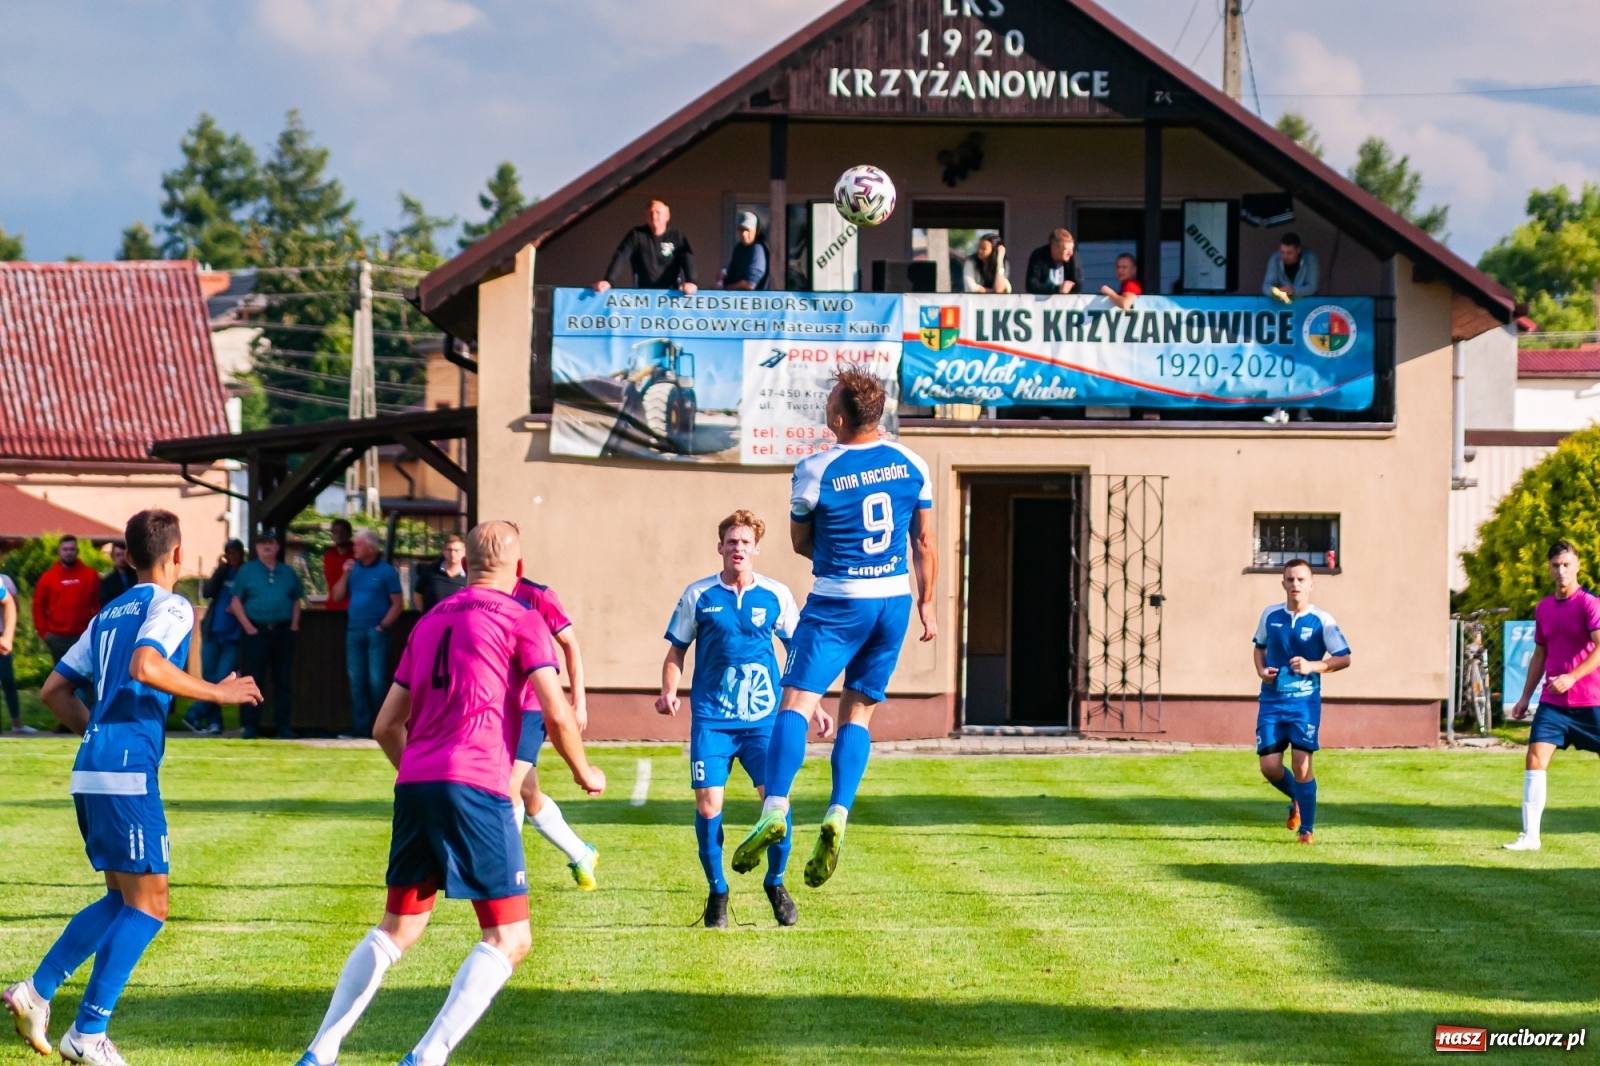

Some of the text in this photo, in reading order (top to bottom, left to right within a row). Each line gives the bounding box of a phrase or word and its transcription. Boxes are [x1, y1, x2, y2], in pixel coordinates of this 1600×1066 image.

[942, 0, 1005, 17] LKS
[918, 28, 1025, 57] 1920
[828, 62, 1110, 99] KRZYŻANOWICE
[815, 224, 857, 269] BINGO
[1186, 223, 1226, 268] BINGO
[606, 294, 649, 308] A&M
[641, 316, 766, 333] DROGOWYCH
[773, 320, 842, 334] Mateusz
[976, 309, 1033, 342] LKS
[788, 349, 890, 363] PRD KUHN
[1156, 353, 1296, 378] 1920-2020
[1012, 374, 1077, 400] Klubu
[752, 427, 779, 438] tel.
[786, 427, 815, 438] 603
[752, 444, 779, 455] tel.
[785, 443, 814, 455] 663
[832, 463, 910, 492] UNIA RACIBÓRZ
[862, 491, 894, 555] 9
[431, 625, 453, 699] 4
[691, 761, 706, 781] 16
